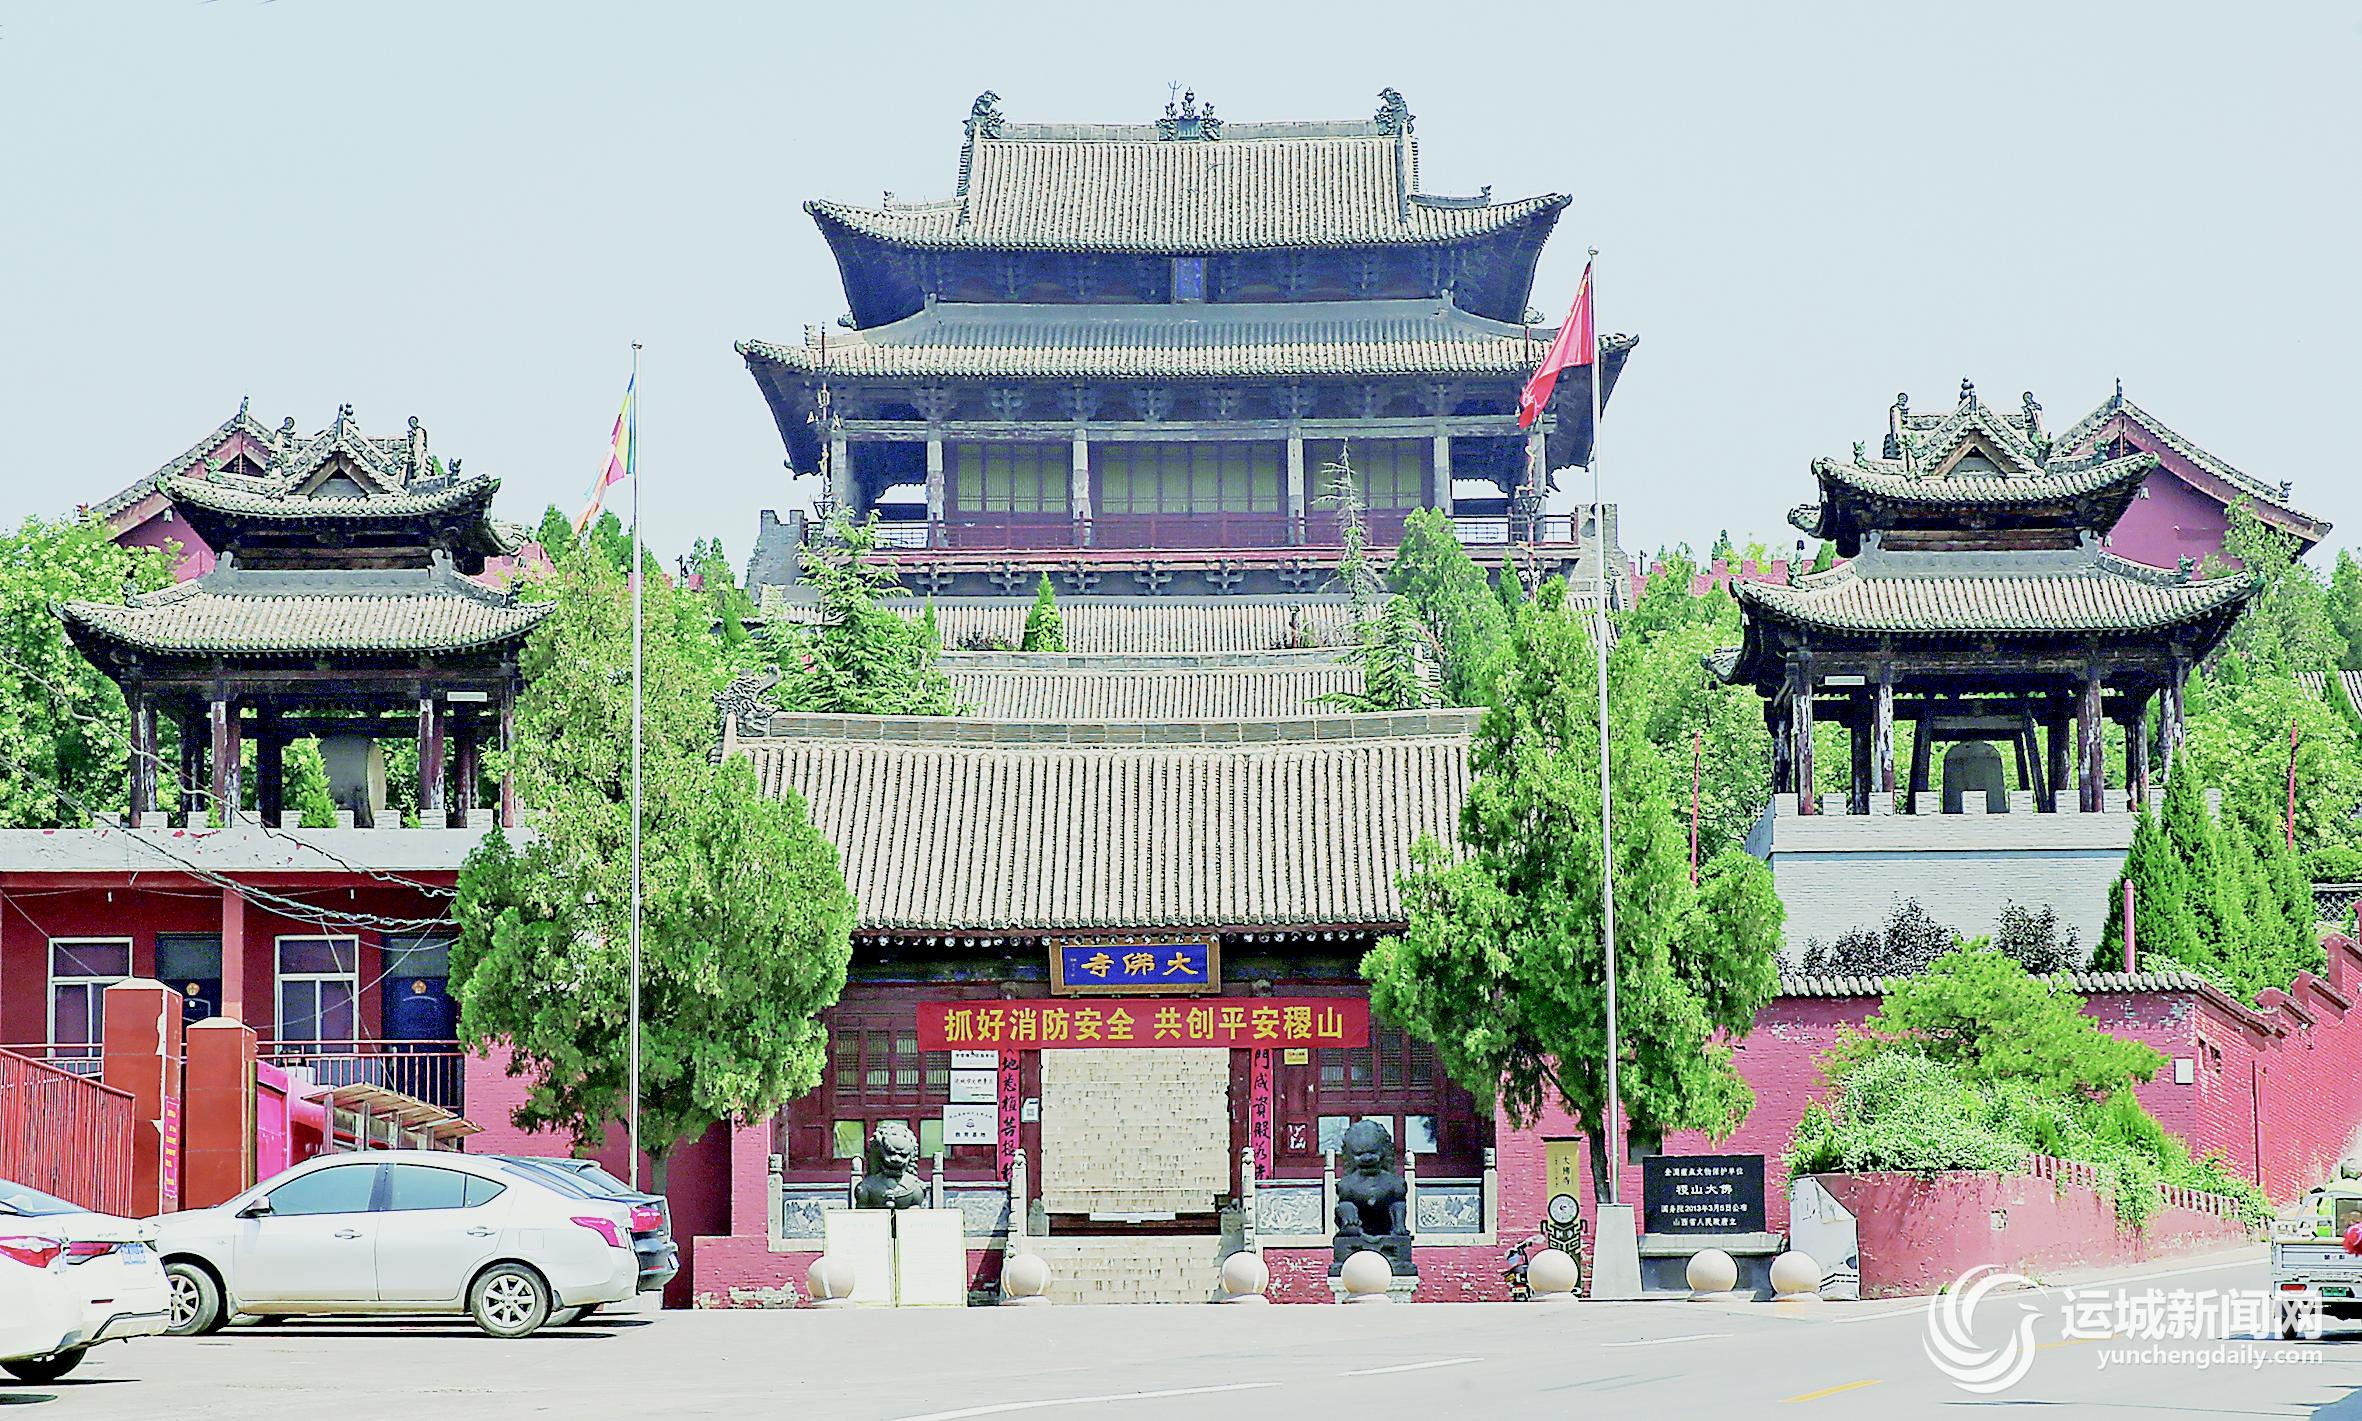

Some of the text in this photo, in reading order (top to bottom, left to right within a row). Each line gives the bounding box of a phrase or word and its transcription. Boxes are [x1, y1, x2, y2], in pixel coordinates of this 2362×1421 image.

[1081, 952, 1199, 978] 大佛寺
[944, 1006, 1343, 1041] 抓好消防安全 共创平安稷山
[1664, 1166, 1744, 1177] 全国重点文物保护单位
[1675, 1183, 1733, 1196] 稷山大佛
[1672, 1217, 1737, 1227] 山西省人民政府立
